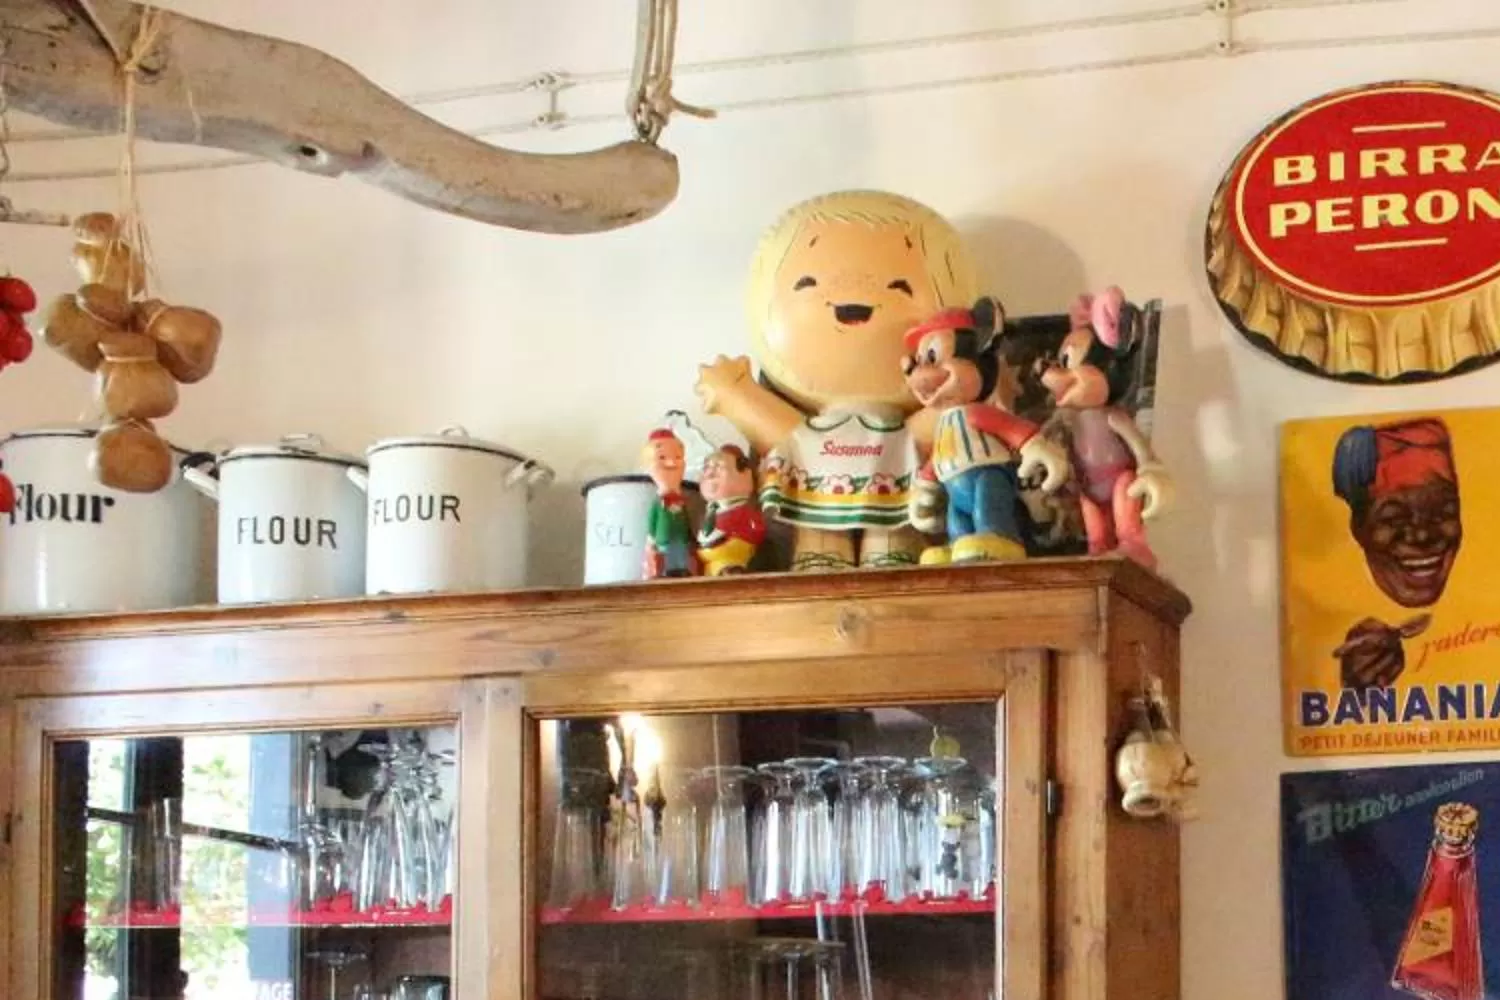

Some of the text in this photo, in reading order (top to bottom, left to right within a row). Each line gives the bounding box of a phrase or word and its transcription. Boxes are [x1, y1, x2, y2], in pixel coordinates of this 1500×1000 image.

[372, 494, 461, 526] FLOUR
[236, 516, 338, 549] FLOUR
[1302, 734, 1347, 750] PETIT
